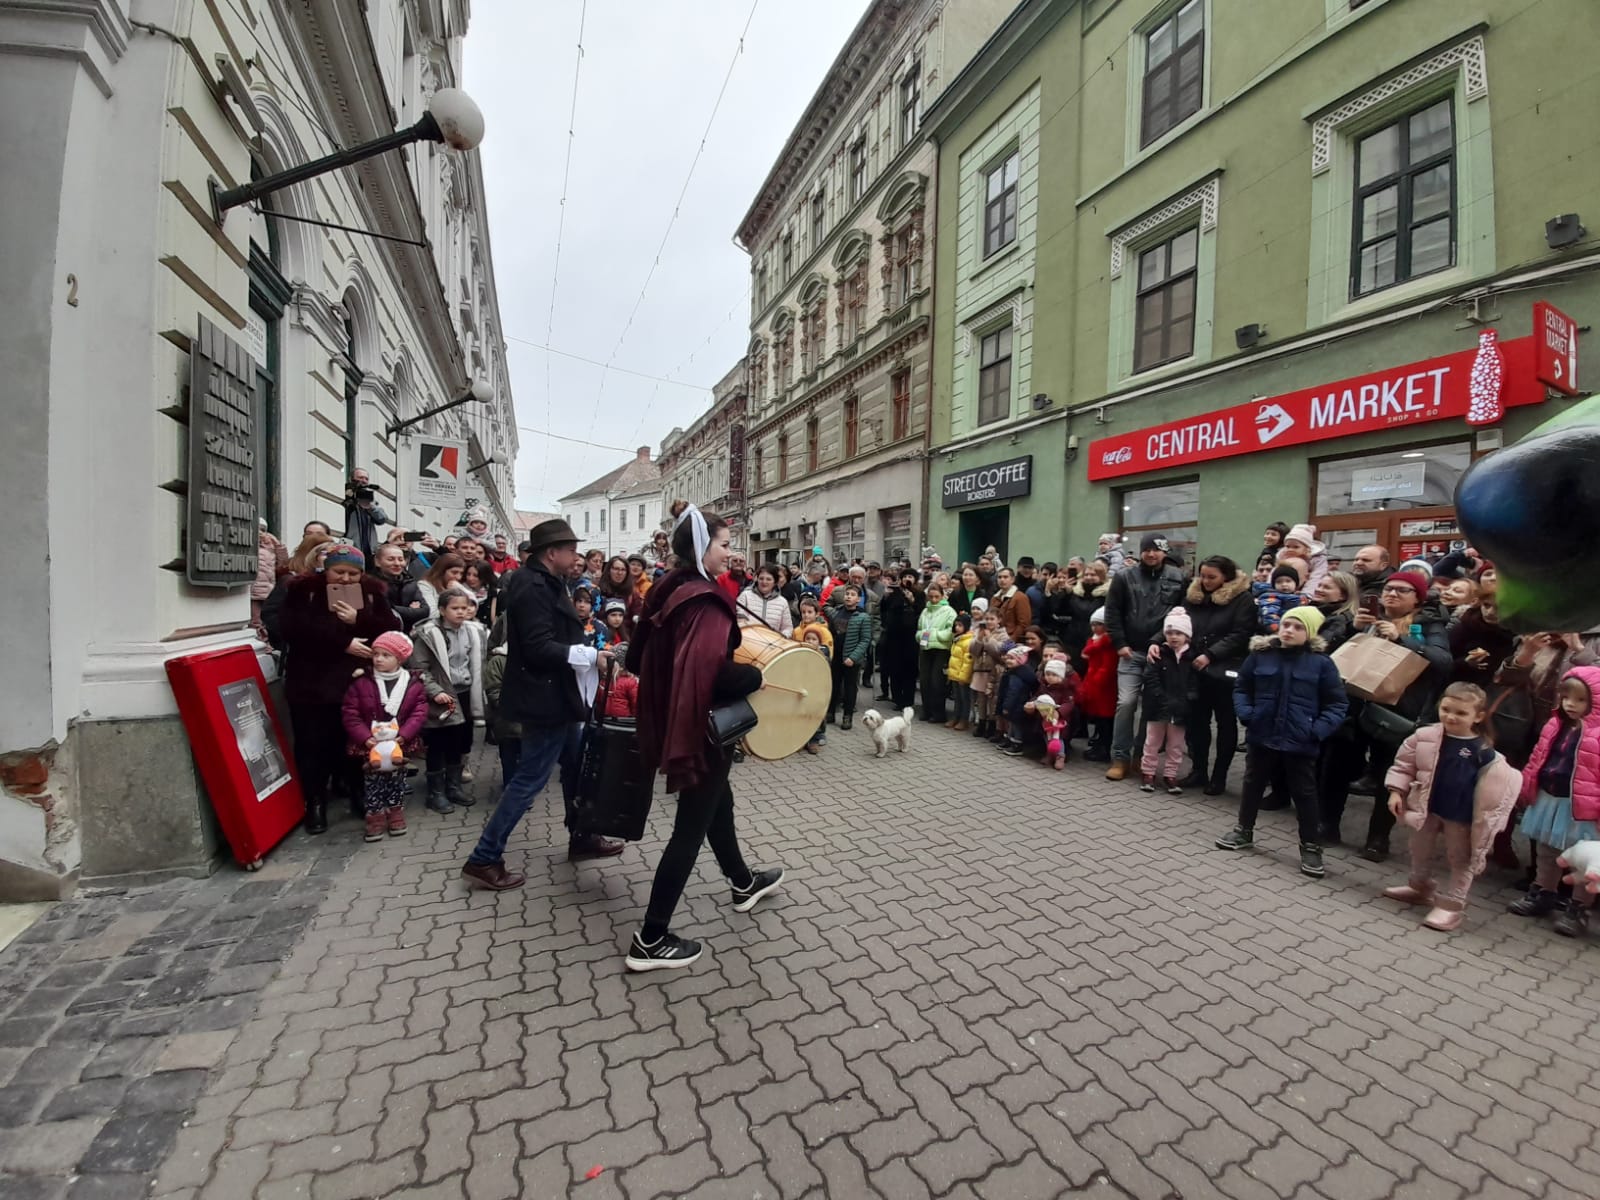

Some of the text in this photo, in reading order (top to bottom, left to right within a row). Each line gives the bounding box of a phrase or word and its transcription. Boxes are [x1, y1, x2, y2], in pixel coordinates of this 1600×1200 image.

[67, 273, 79, 308] 2
[1545, 308, 1568, 338] CENTRAL
[1546, 328, 1568, 356] MARKET
[1147, 367, 1451, 461] CENTRAL MARKET
[1387, 413, 1409, 424] SHOP
[1426, 408, 1438, 417] GO
[944, 462, 1027, 495] STREET COFFEE
[967, 488, 997, 501] ROASTERS
